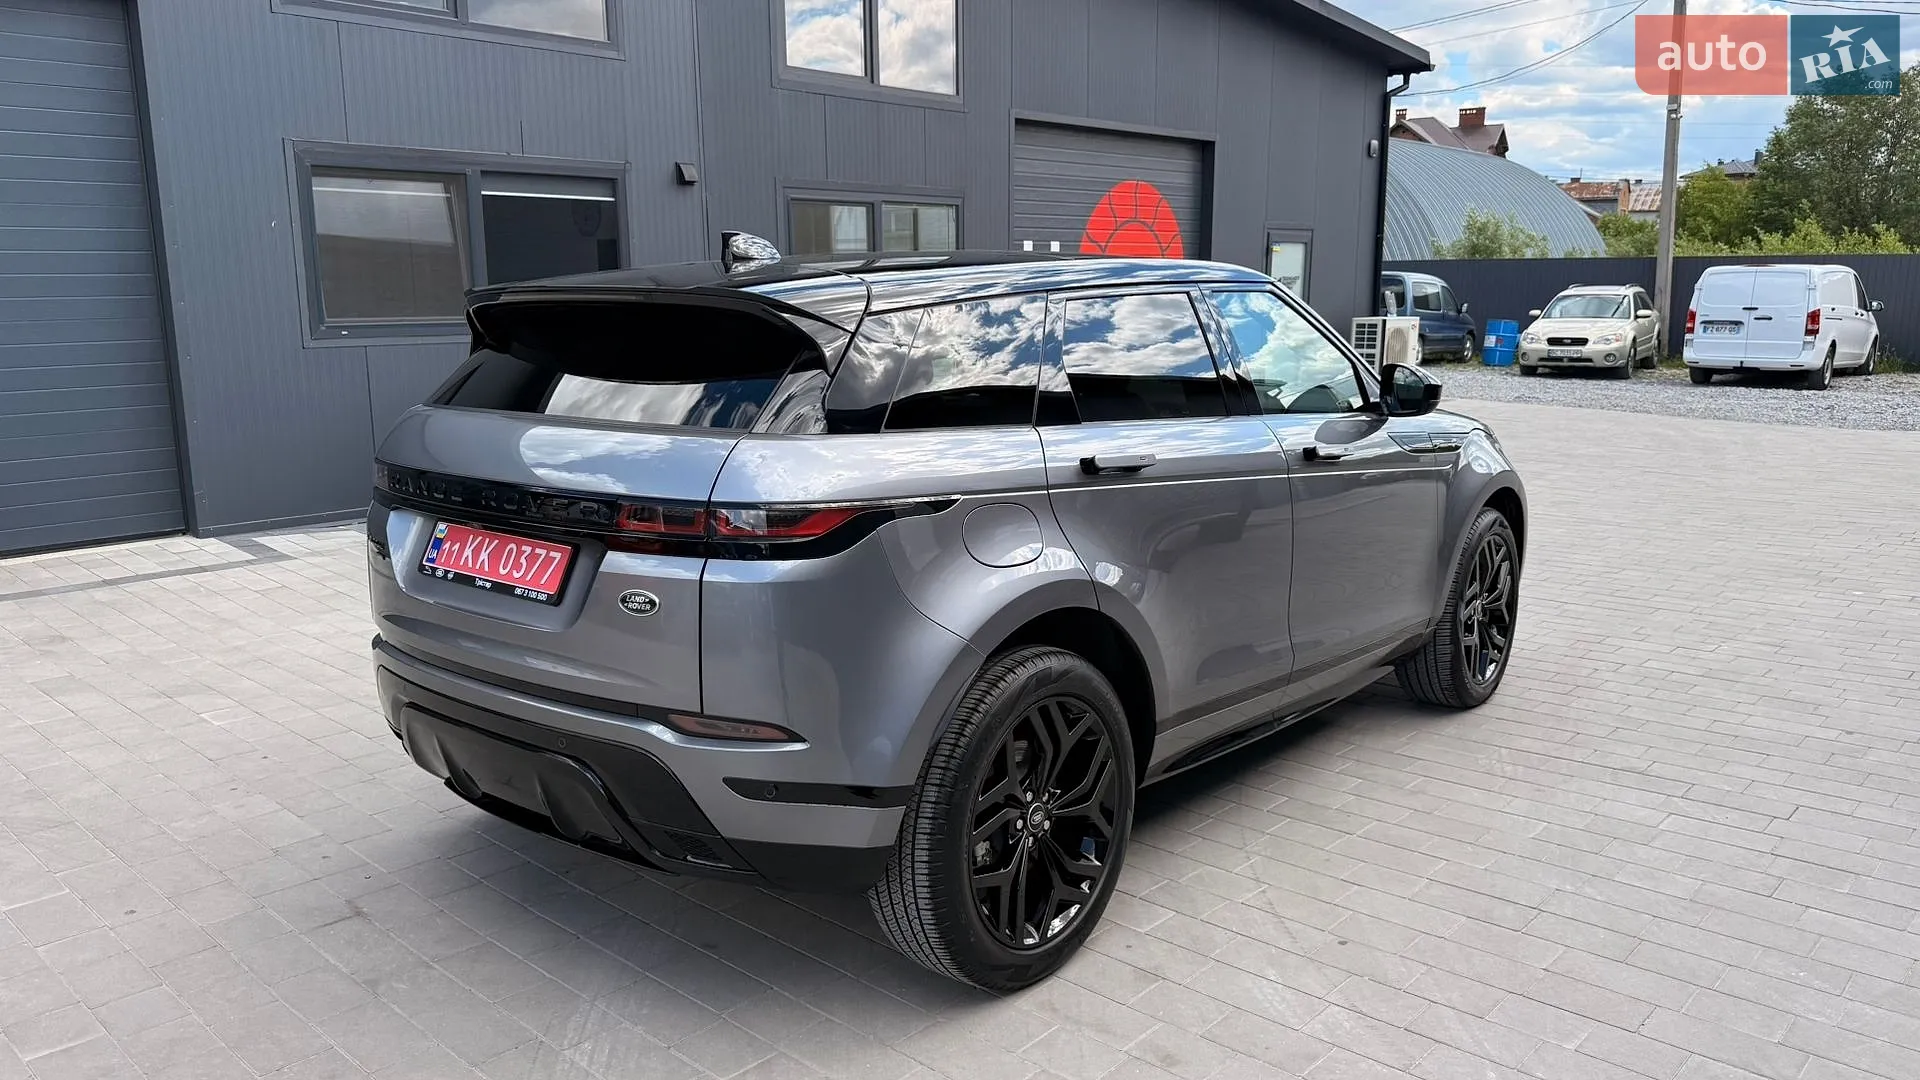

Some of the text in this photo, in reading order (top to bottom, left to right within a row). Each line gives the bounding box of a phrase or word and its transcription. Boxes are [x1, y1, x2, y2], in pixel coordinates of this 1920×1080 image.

[428, 548, 438, 559] UA
[499, 543, 562, 585] 0377
[626, 595, 645, 603] LAND
[627, 602, 651, 610] ROVER
